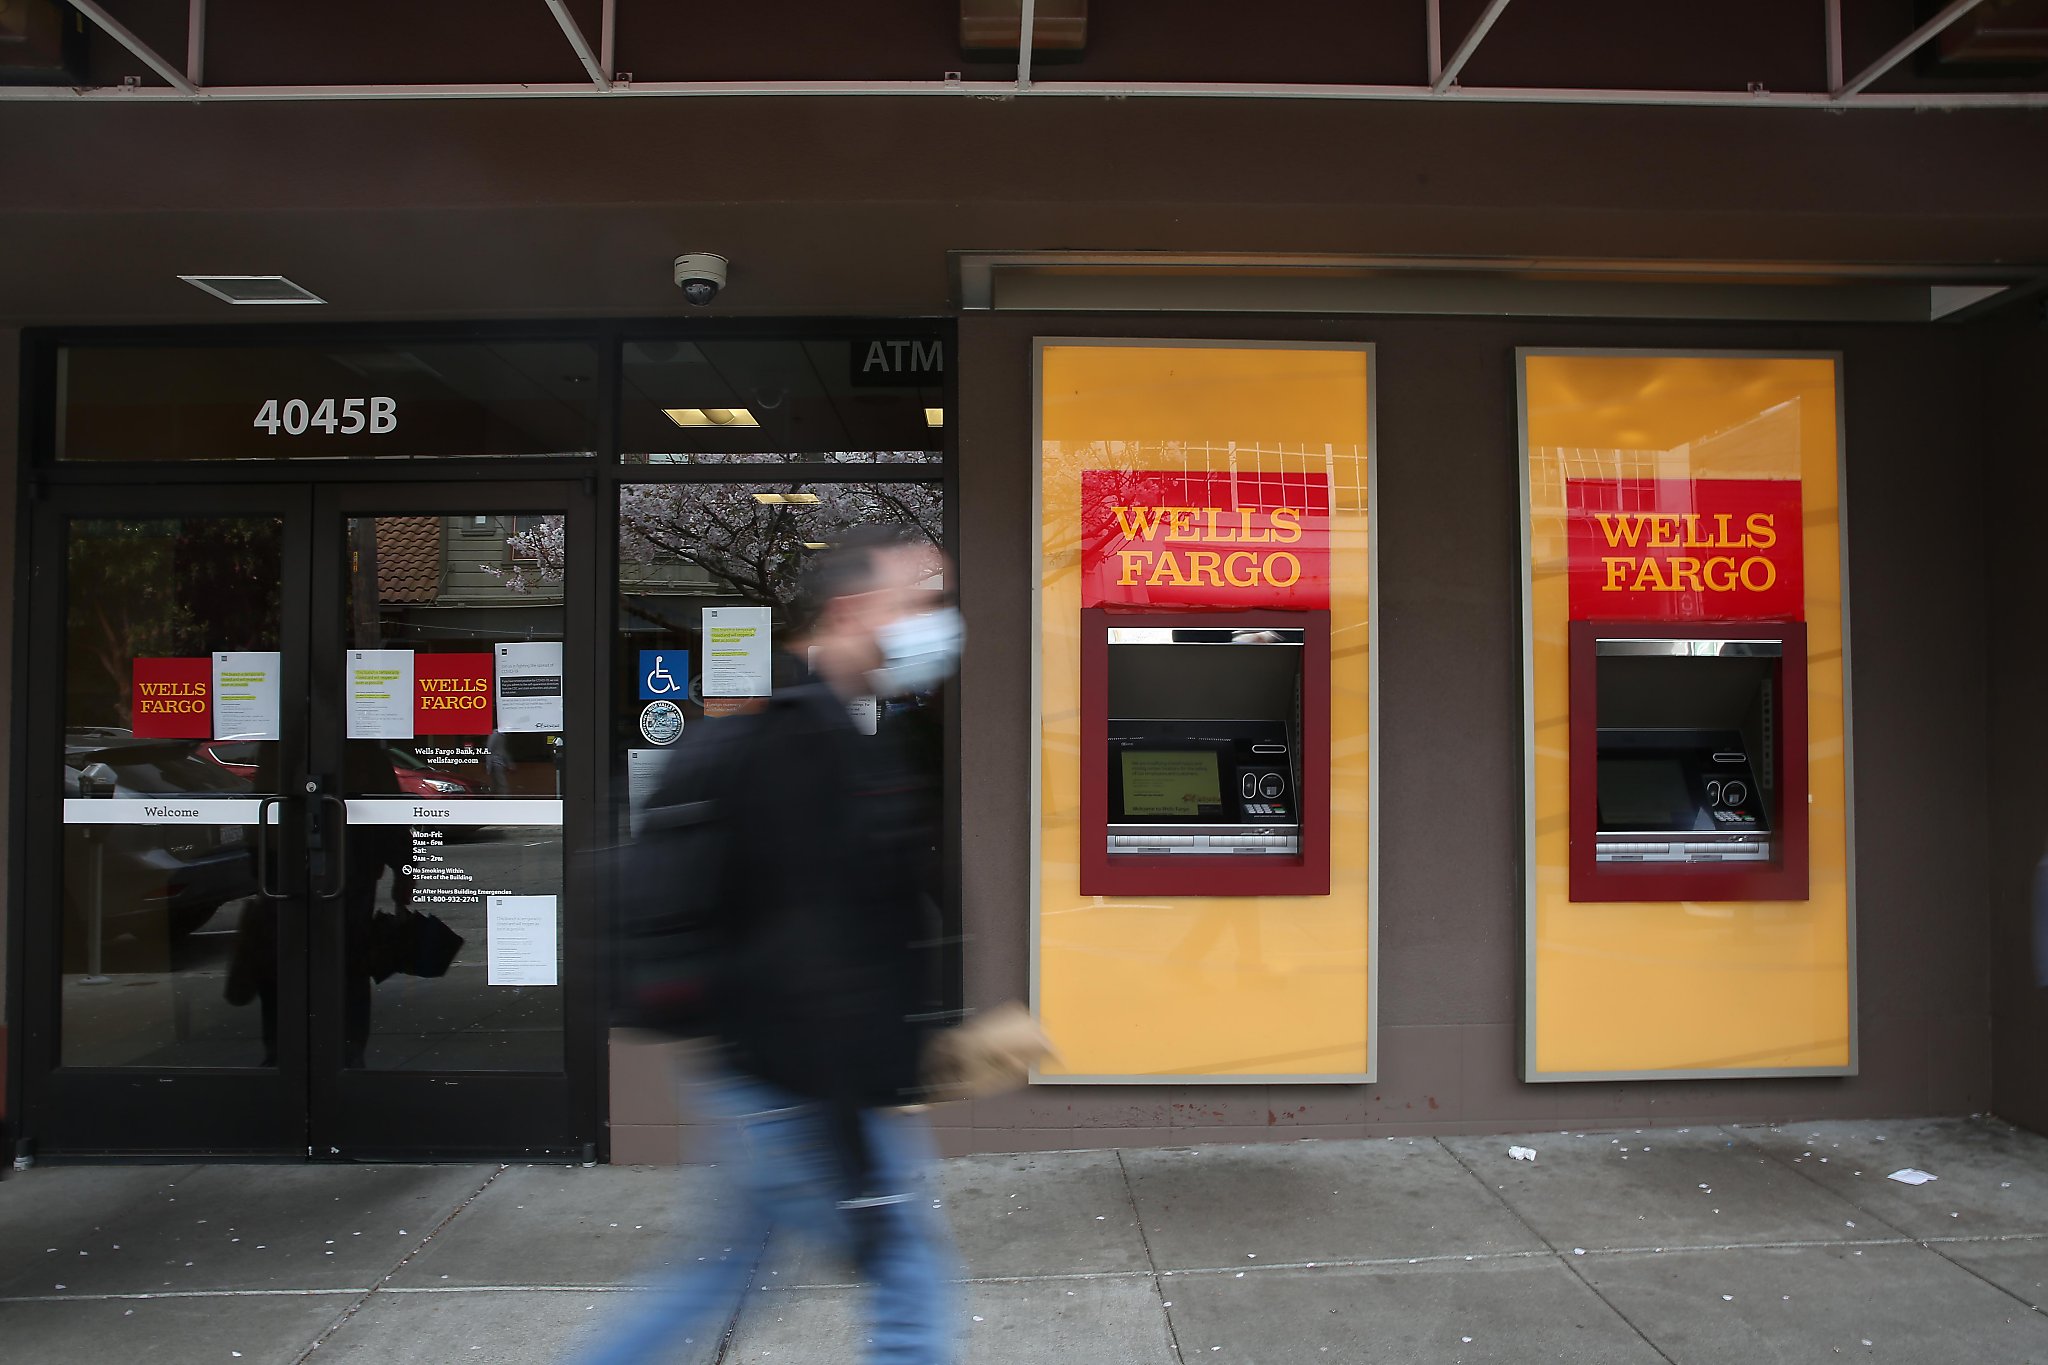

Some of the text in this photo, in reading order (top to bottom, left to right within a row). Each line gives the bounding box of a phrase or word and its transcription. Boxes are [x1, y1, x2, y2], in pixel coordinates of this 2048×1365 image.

[863, 340, 944, 372] ATM
[253, 397, 398, 436] 4045B
[1112, 505, 1302, 544] WELLS
[1595, 512, 1778, 549] WELLS
[1115, 550, 1302, 588] FARGO
[1601, 555, 1777, 593] FARGO
[139, 683, 206, 696] WELLS
[419, 678, 488, 693] WELLS
[140, 700, 206, 714] FARGO
[421, 695, 488, 710] FARGO
[434, 748, 455, 756] Fargo
[456, 748, 475, 756] Bank,
[427, 757, 479, 765] wellsfargo.com
[144, 805, 200, 819] Welcome
[413, 807, 450, 818] Hours
